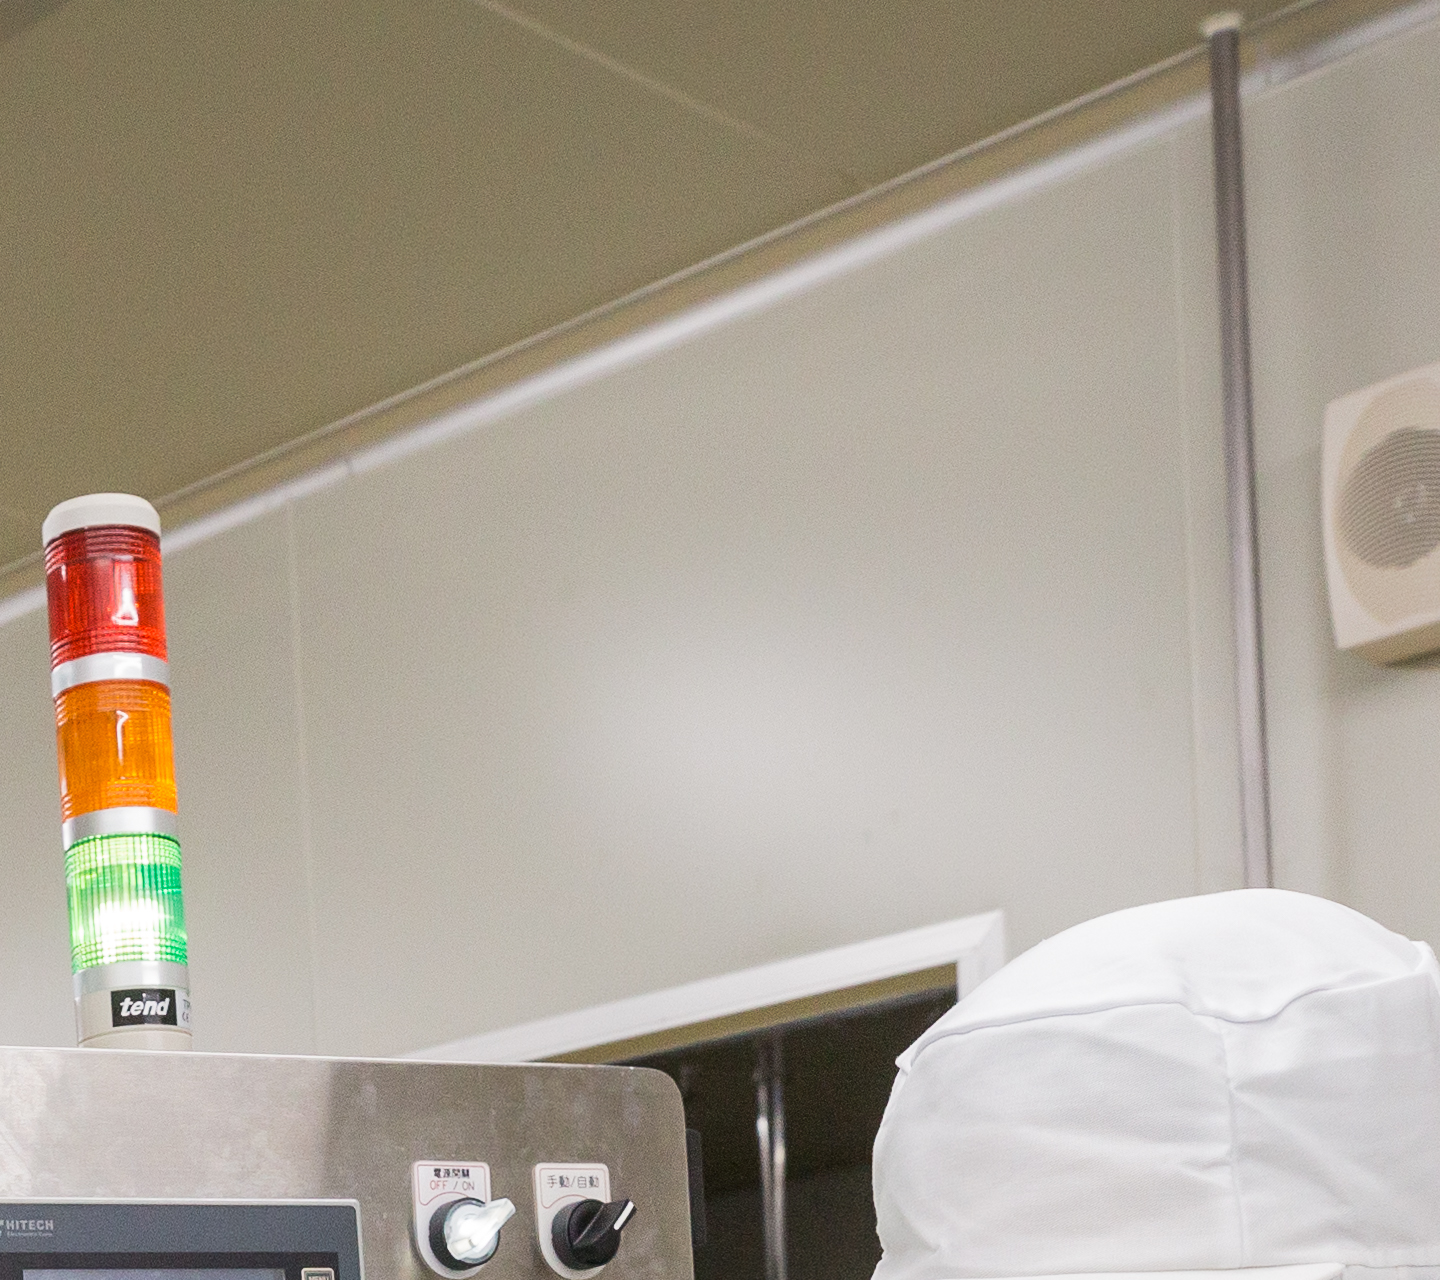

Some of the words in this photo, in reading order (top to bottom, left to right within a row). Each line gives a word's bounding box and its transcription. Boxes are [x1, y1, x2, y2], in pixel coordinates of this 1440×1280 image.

[120, 997, 170, 1017] tend
[430, 1180, 448, 1190] OFF
[462, 1181, 475, 1191] ON
[547, 1175, 599, 1188] 手動/自動
[6, 1220, 54, 1231] HITECH
